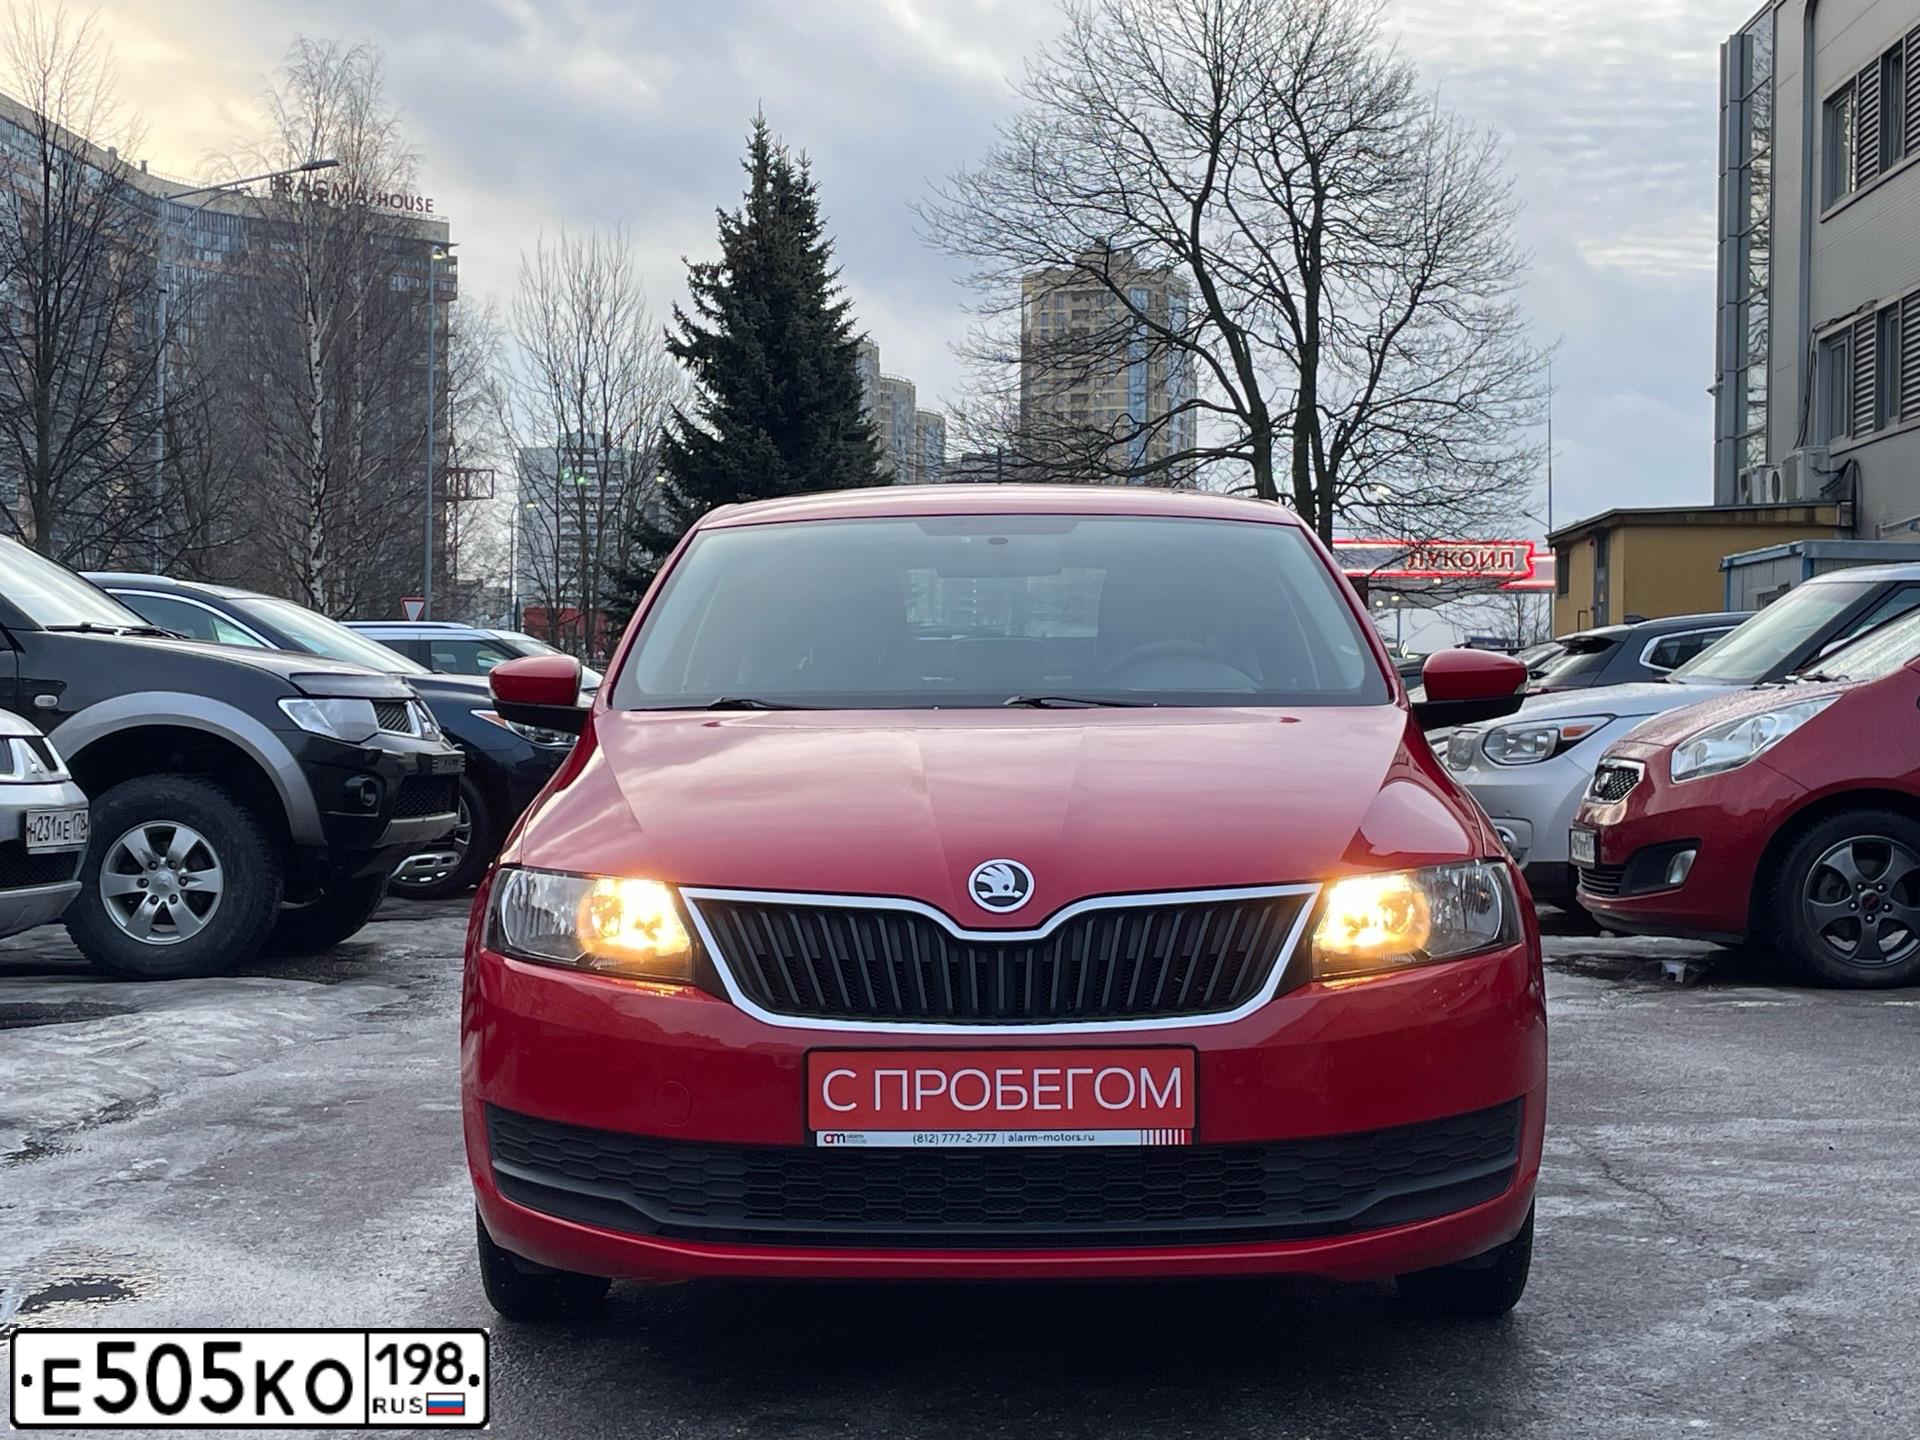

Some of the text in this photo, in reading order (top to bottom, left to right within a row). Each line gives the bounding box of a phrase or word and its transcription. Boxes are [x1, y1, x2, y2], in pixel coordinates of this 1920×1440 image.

[376, 191, 434, 213] HOUSE
[821, 1066, 1182, 1112] С ПРОБЕГОМ
[912, 1132, 1095, 1145] (812) 777-2-777 alarm-motors.ru
